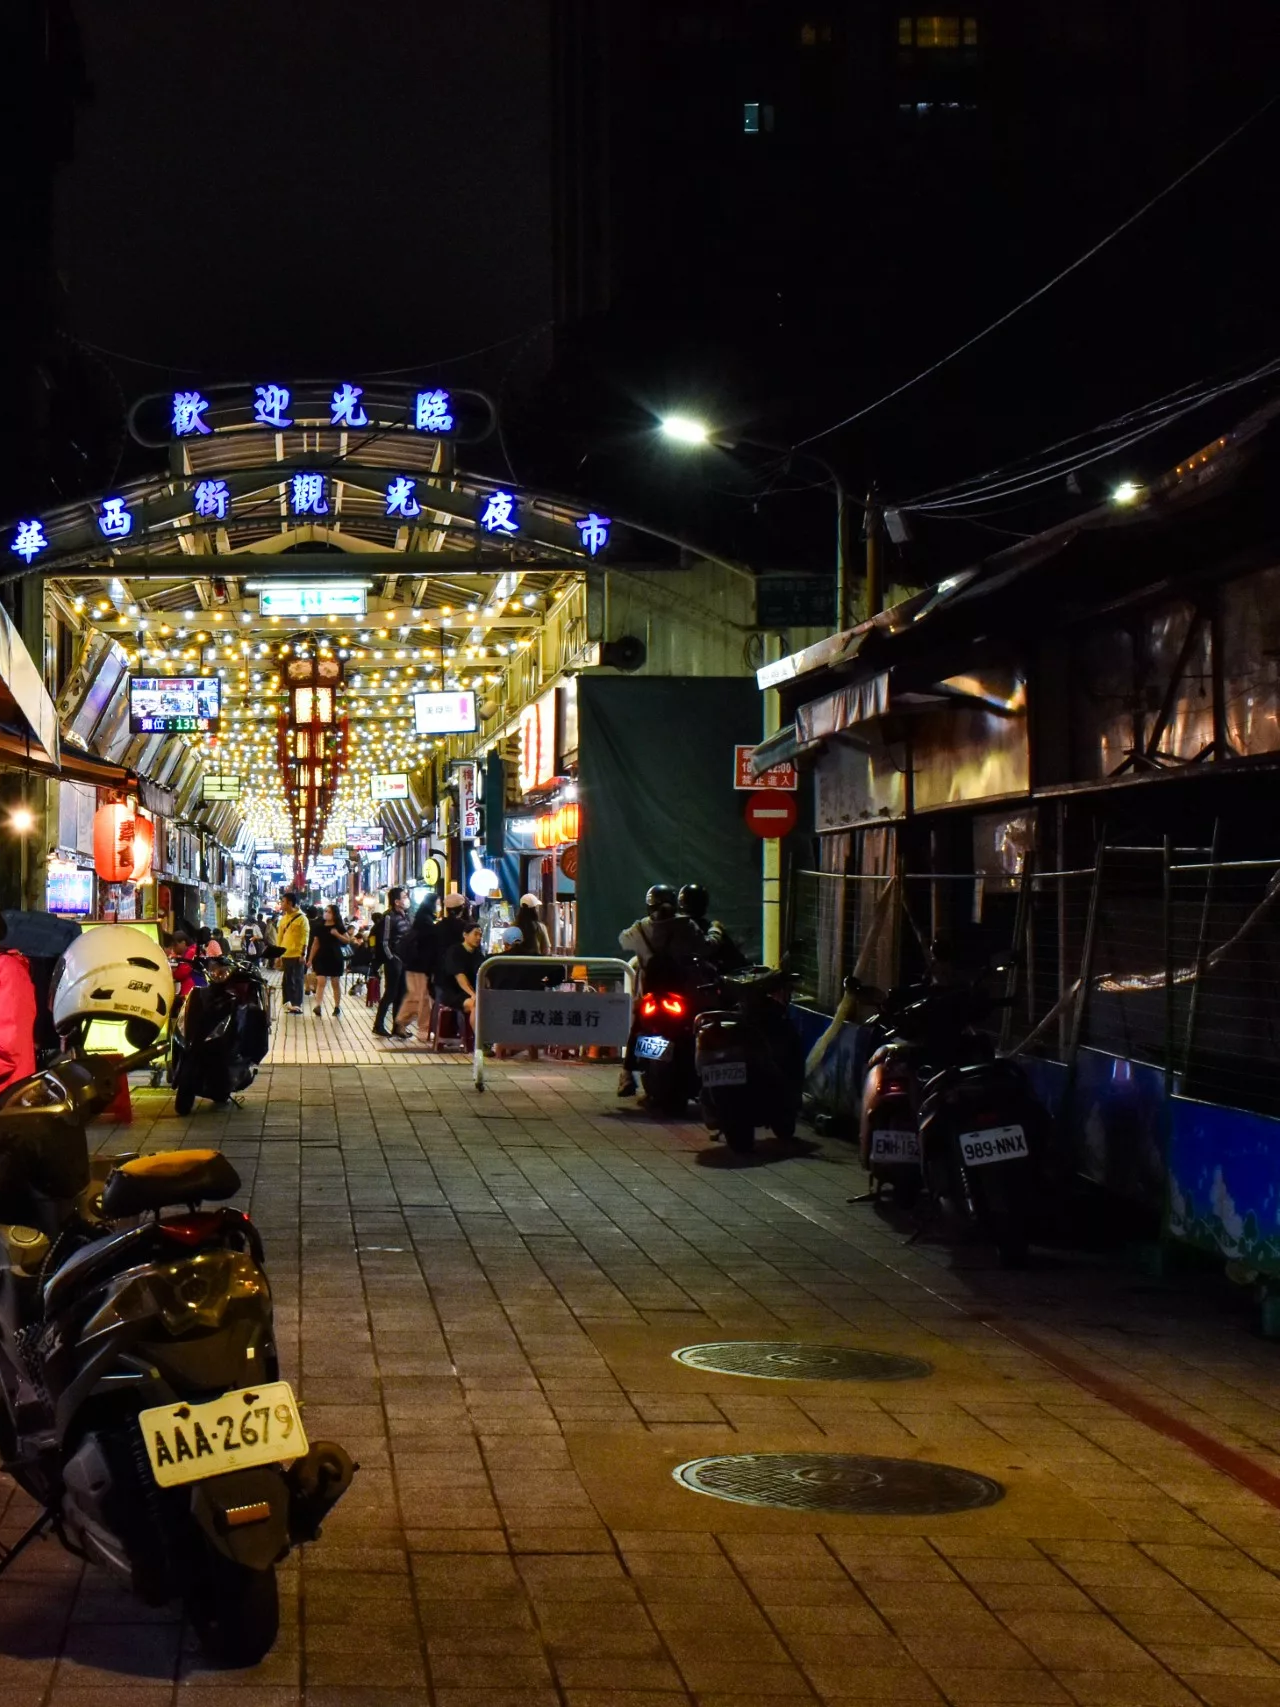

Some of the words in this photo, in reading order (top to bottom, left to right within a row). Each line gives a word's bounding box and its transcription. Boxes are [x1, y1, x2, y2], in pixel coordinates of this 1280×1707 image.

[171, 384, 454, 435] 歡迎光臨
[11, 472, 612, 564] 華西街觀光夜市
[512, 1009, 600, 1027] 請改道通行
[964, 1135, 1026, 1160] 989-NNX
